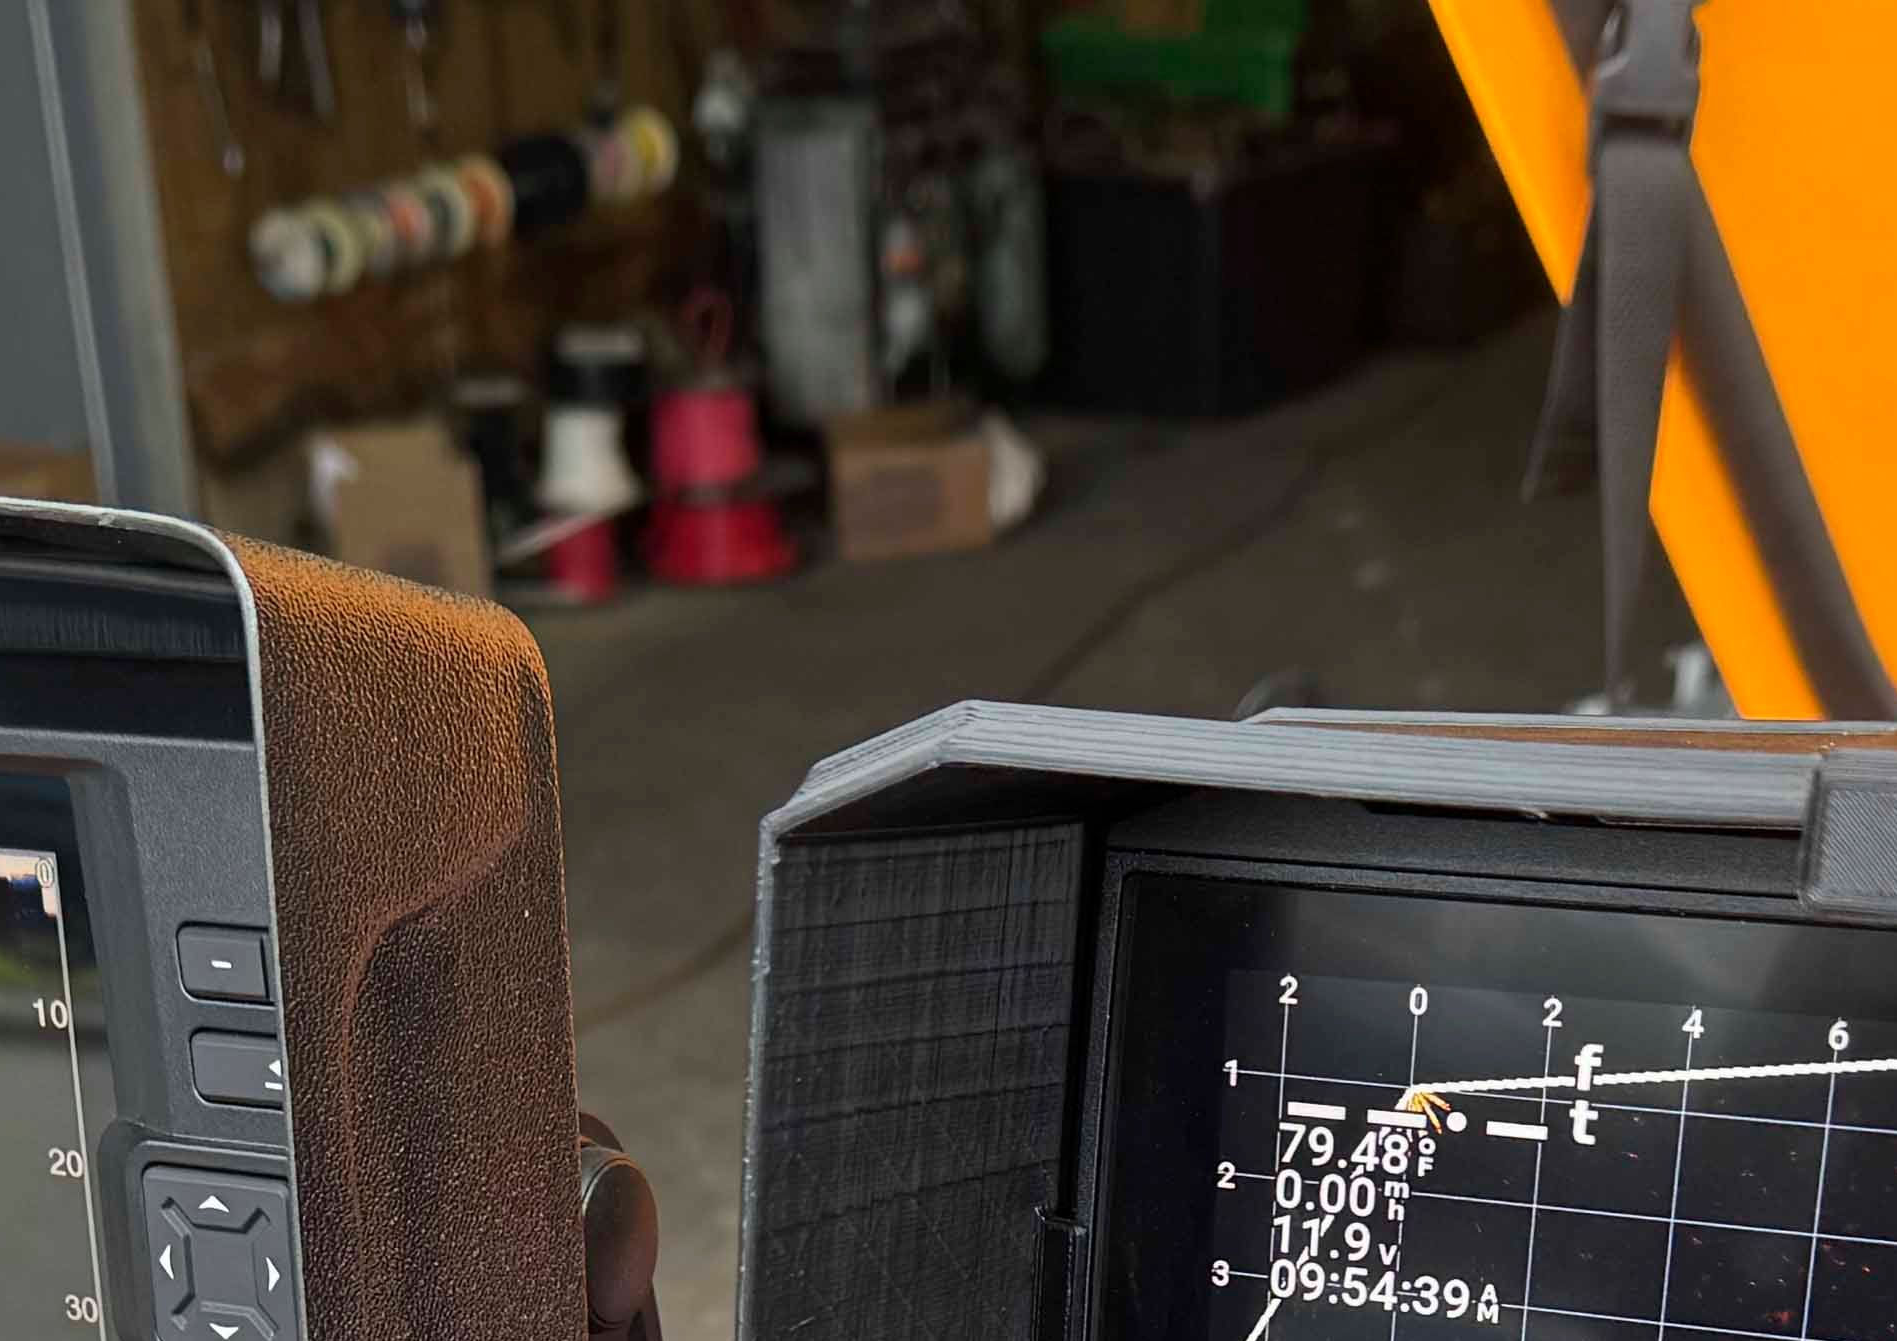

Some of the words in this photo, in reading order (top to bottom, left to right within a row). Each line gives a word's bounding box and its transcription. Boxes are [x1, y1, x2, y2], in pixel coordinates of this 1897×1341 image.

[33, 1000, 68, 1030] 10
[1279, 976, 1299, 1005] 2
[1409, 987, 1428, 1015] 0
[1542, 999, 1563, 1027] 2
[1683, 1010, 1704, 1038] 4
[1828, 1021, 1848, 1050] 6
[1224, 1060, 1239, 1086] 1
[49, 1147, 84, 1178] 20
[1278, 1122, 1409, 1175] 79.48
[1217, 1163, 1237, 1189] 2
[1275, 1169, 1377, 1218] 0.00
[1273, 1216, 1372, 1262] 11.9
[1211, 1261, 1230, 1286] 3
[1270, 1261, 1470, 1320] 09:54:39
[66, 1295, 99, 1323] 30
